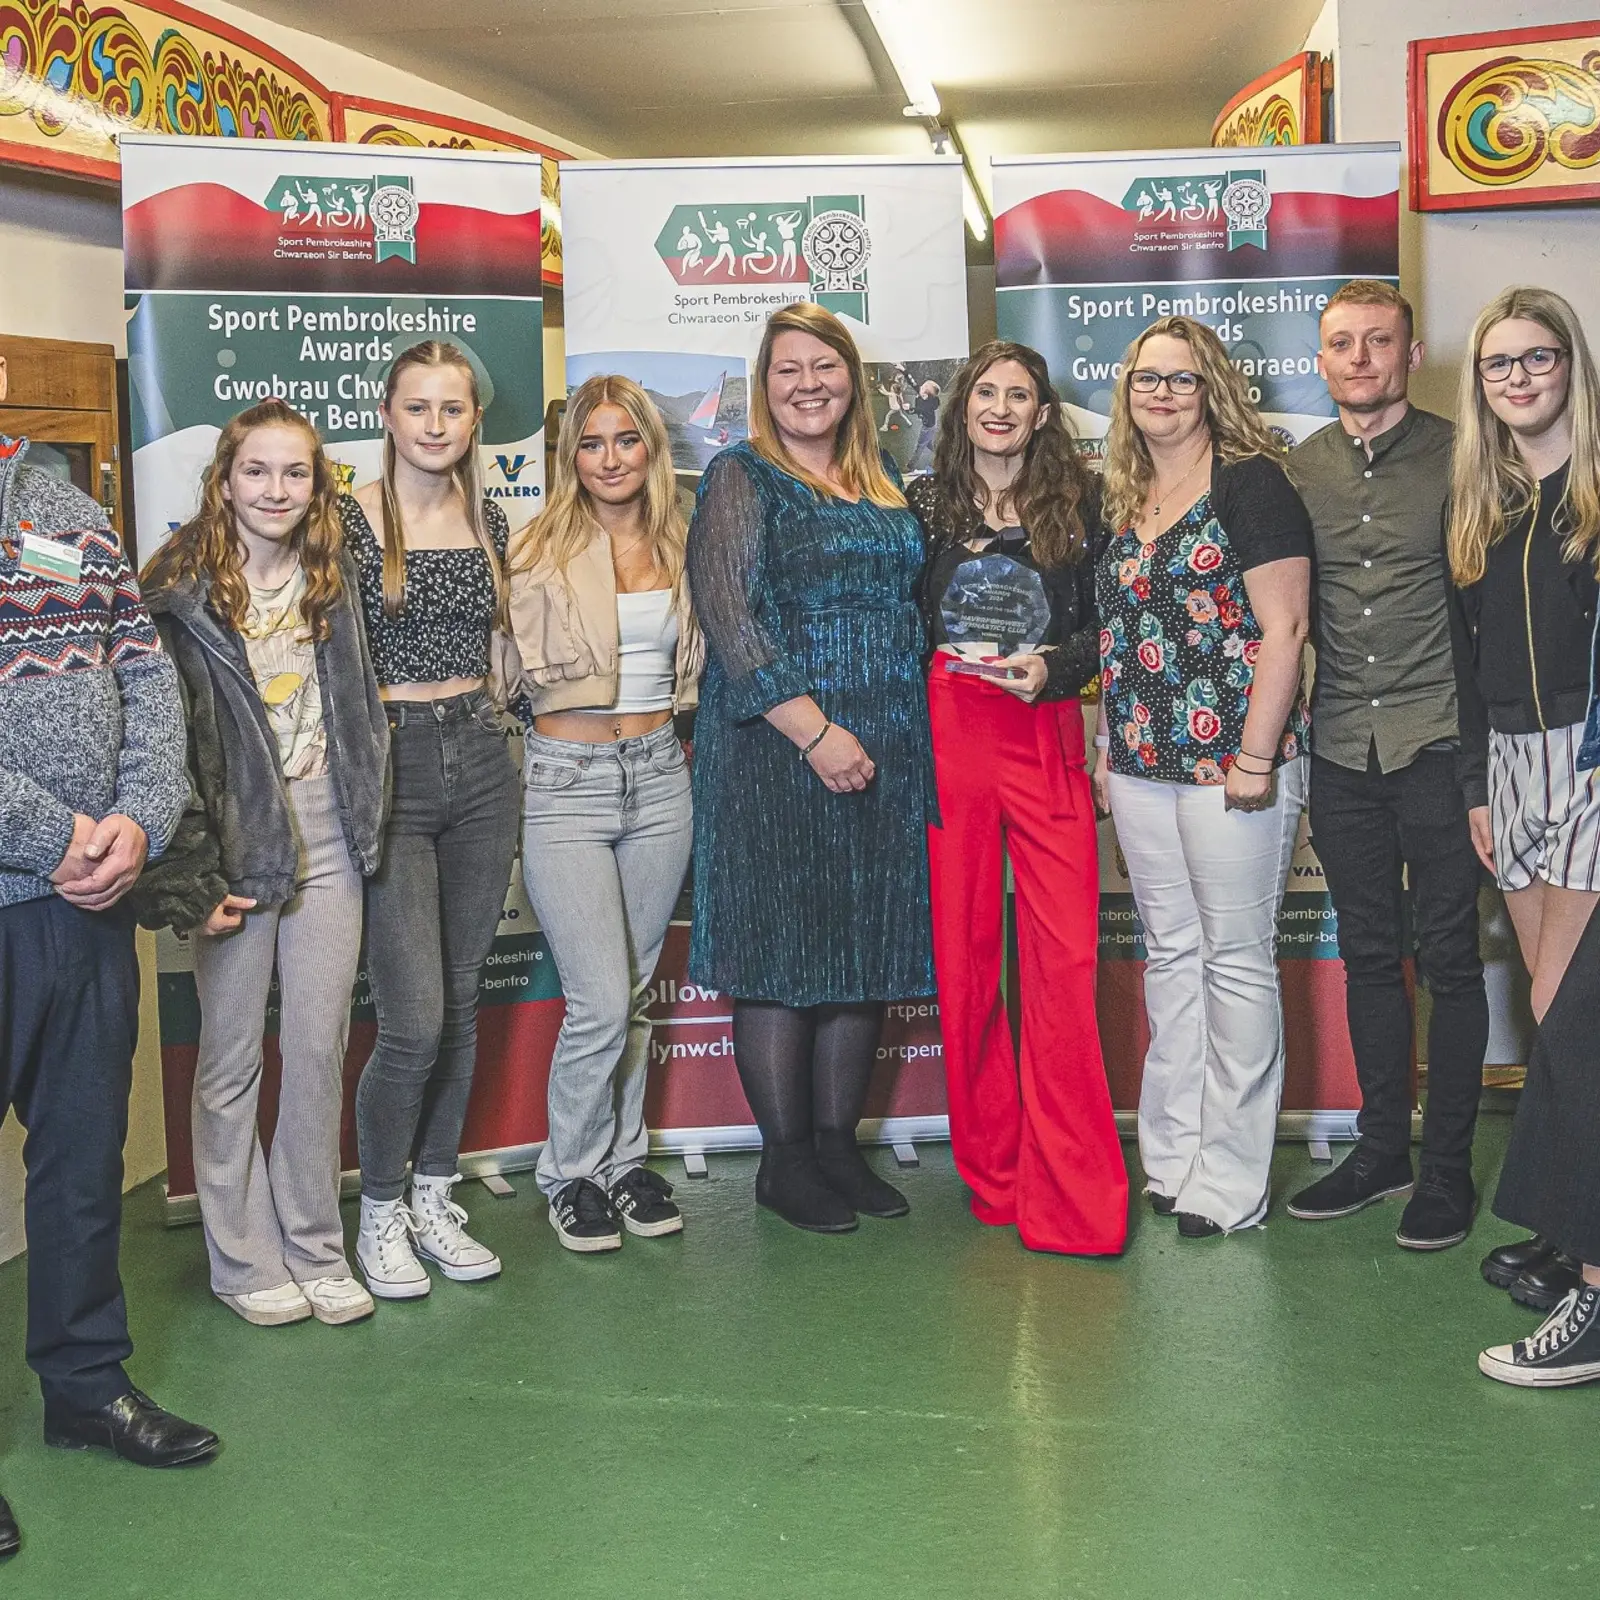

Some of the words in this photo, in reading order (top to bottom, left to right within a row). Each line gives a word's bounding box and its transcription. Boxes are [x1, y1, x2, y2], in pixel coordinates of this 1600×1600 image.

[278, 237, 304, 247] Sport
[306, 237, 372, 248] Pembrokeshire
[1134, 232, 1158, 242] Sport
[1160, 231, 1224, 240] Pembrokeshire
[1129, 243, 1179, 252] Chwaraeon
[1181, 243, 1193, 251] Sir
[1195, 241, 1225, 250] Benfro
[273, 249, 325, 259] Chwaraeon
[327, 250, 340, 259] Sir
[342, 251, 372, 260] Benfro
[674, 294, 709, 308] Sport
[713, 292, 805, 305] Pembrokeshire
[1068, 295, 1135, 326] Sport
[1142, 289, 1329, 317] Pembrokeshire
[208, 304, 280, 338] Sport
[287, 305, 477, 332] Pembrokeshire
[668, 312, 740, 325] Chwaraeon
[744, 311, 761, 322] Sir
[299, 336, 393, 362] Awards
[213, 374, 329, 401] Gwobrau
[483, 486, 541, 498] VALERO
[1008, 626, 1028, 635] CLUB
